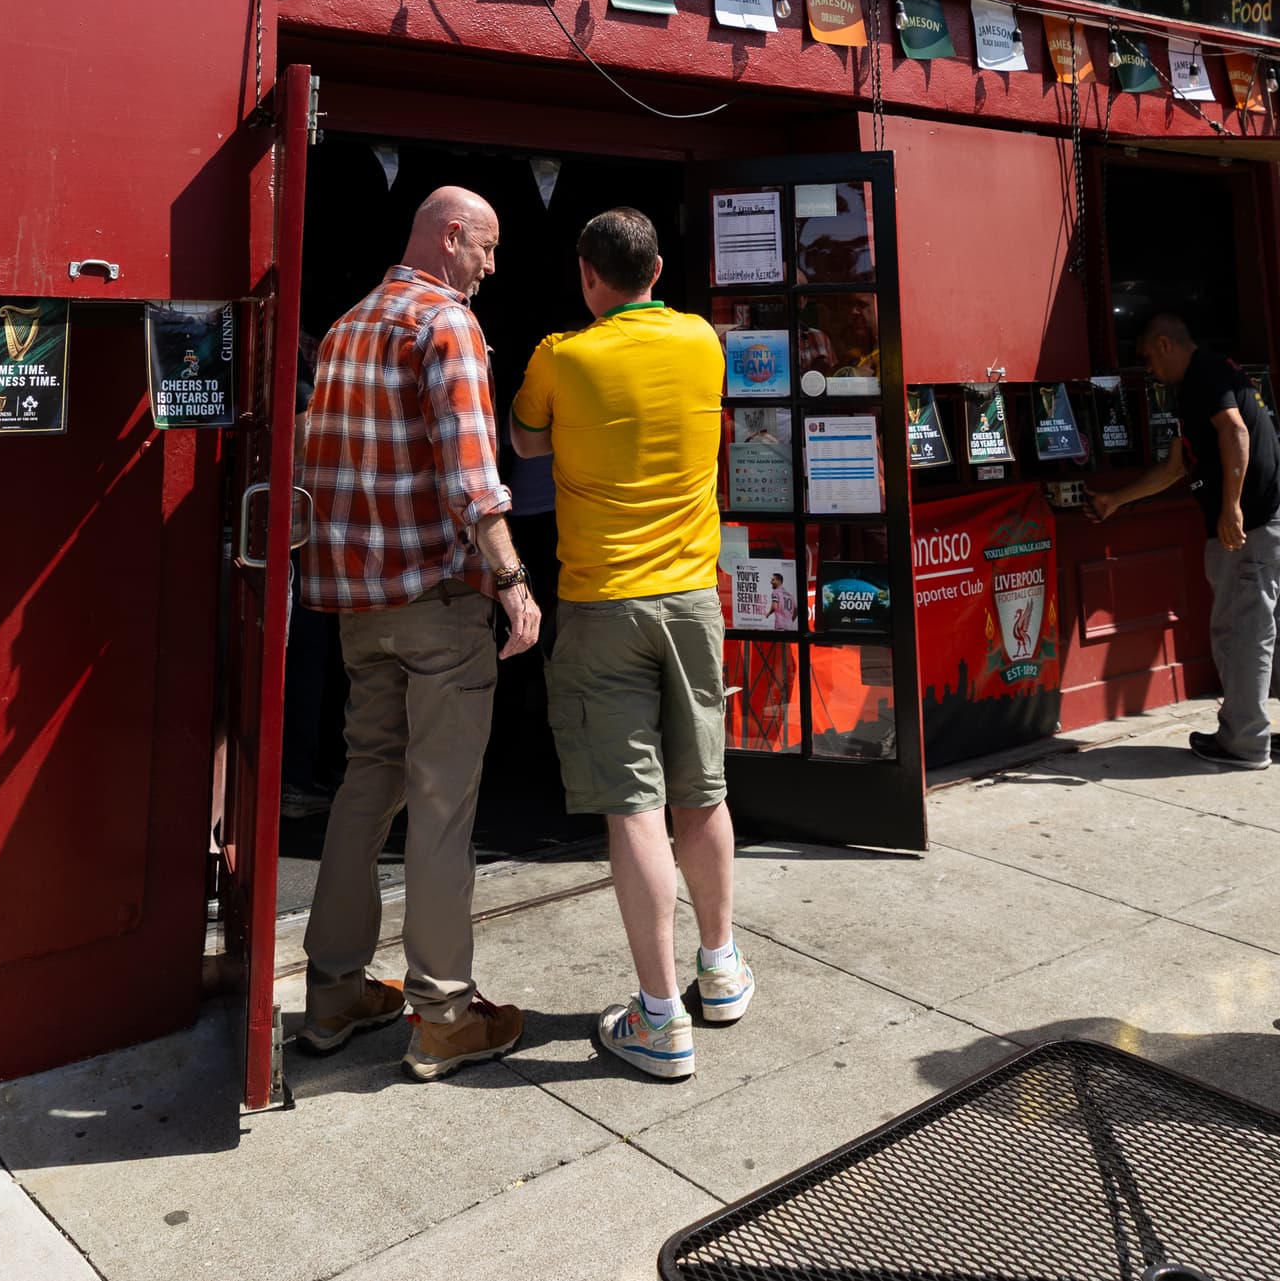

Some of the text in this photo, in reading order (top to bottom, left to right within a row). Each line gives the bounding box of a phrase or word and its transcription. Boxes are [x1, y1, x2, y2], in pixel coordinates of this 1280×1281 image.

[906, 16, 940, 33] AMESON
[979, 26, 1012, 40] JAMESON
[1048, 39, 1082, 56] JAMESN
[17, 364, 48, 375] TIME.
[29, 376, 60, 387] TIME.
[161, 379, 219, 392] CHEERS TO
[175, 391, 209, 404] YEARS
[211, 391, 225, 403] OF
[157, 403, 225, 416] IRISH RUGBY!
[736, 571, 760, 582] YOU'VE
[994, 567, 1045, 591] LIVERPOOL
[736, 581, 758, 593] NEVER
[916, 578, 984, 608] pporter Club
[736, 592, 753, 603] SEEN
[837, 591, 874, 601] AGAIN
[997, 590, 1027, 603] FOOTBALL
[737, 603, 752, 614] LIKE
[839, 601, 872, 611] SOON
